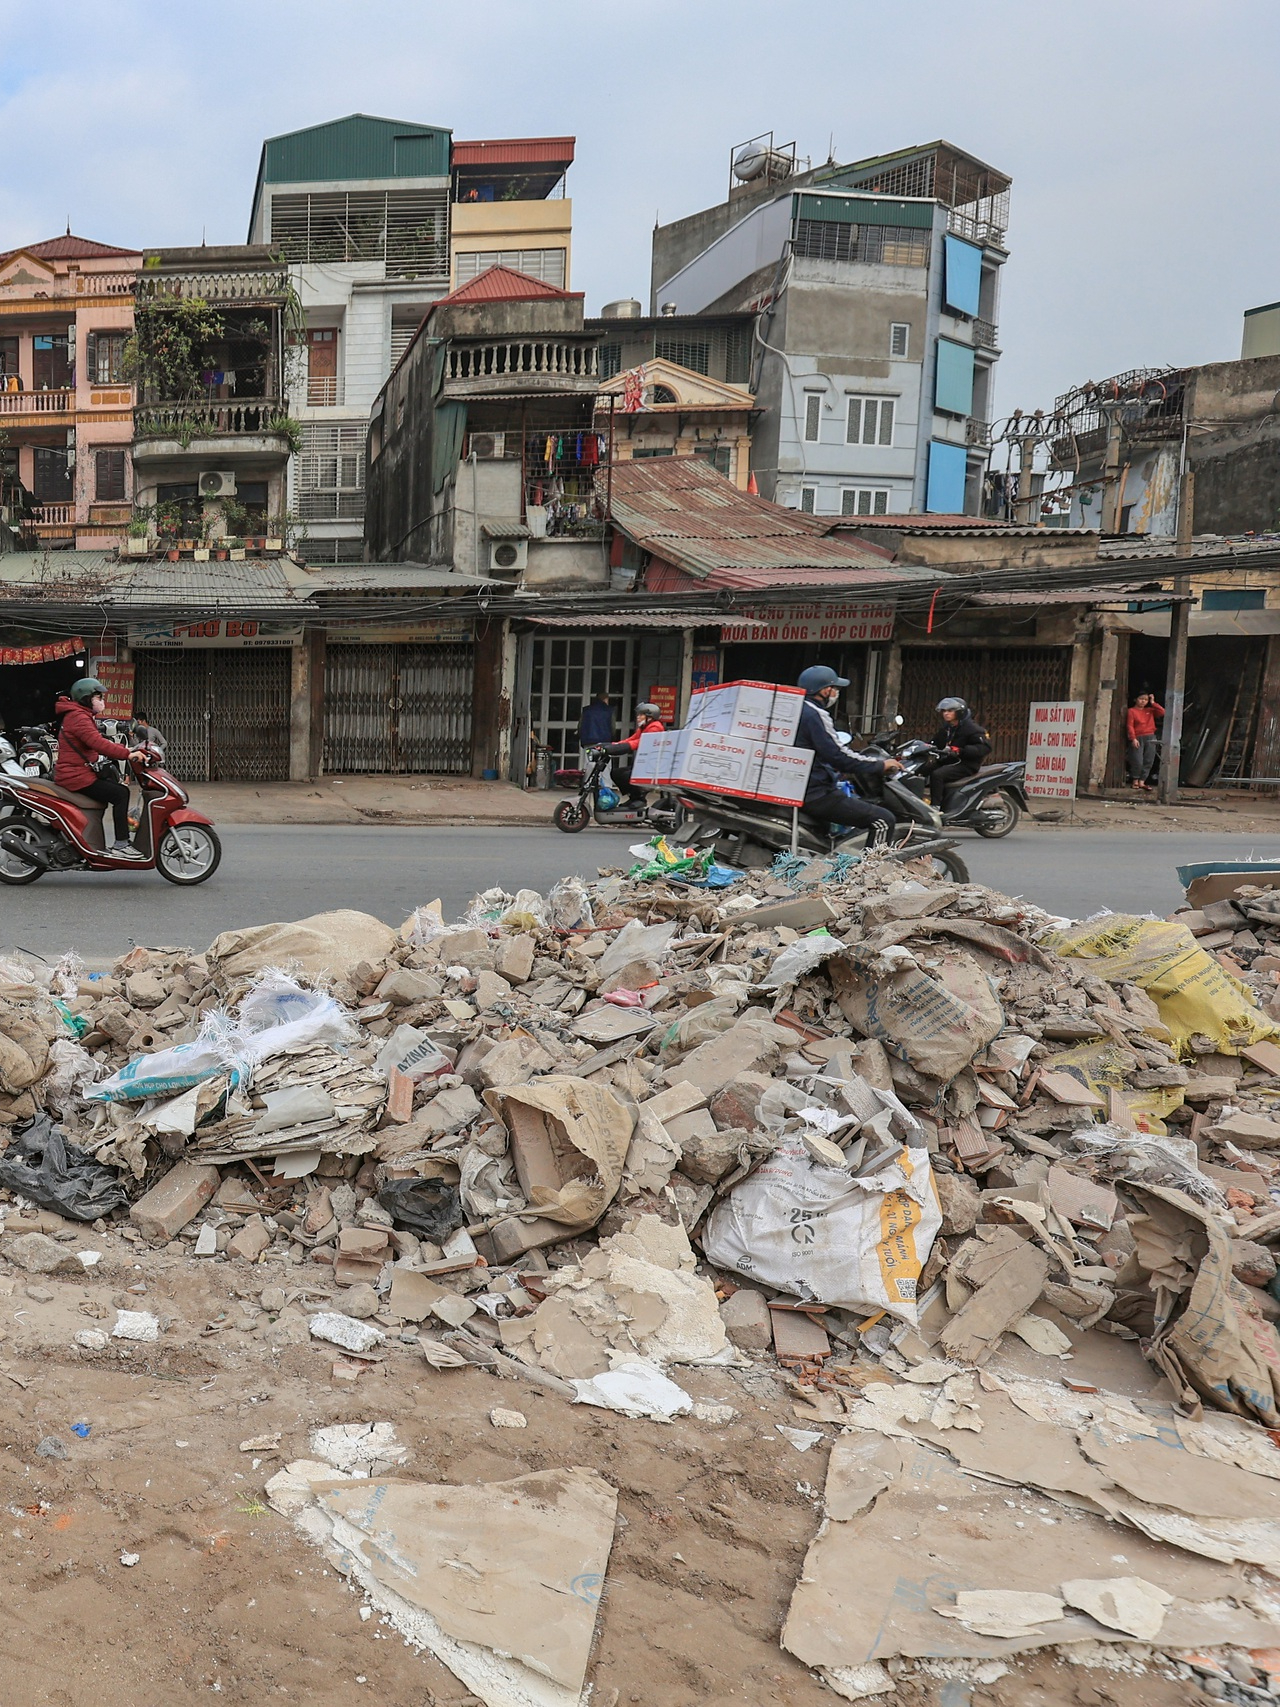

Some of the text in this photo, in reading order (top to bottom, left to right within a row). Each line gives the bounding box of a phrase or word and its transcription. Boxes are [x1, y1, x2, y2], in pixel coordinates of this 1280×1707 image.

[720, 626, 748, 641] MUA
[782, 621, 808, 640] ỐNG
[820, 623, 846, 642] HỘP
[850, 622, 867, 640] CŨ
[1035, 703, 1076, 726] MUA SẮT VỤN
[737, 721, 781, 734] ARISTON
[1029, 730, 1042, 746] BÁN
[1047, 732, 1060, 747] CHO
[703, 742, 746, 756] ARISTON
[764, 753, 807, 766] ARISTON
[1035, 774, 1046, 782] 377
[1047, 775, 1058, 783] Tam
[1059, 775, 1073, 784] Trinh
[1032, 787, 1046, 795] 0974
[1047, 787, 1055, 795] 27
[1056, 788, 1070, 796] 1289
[155, 1082, 167, 1090] CHO
[790, 1207, 813, 1224] 25
[792, 1251, 802, 1259] ISO
